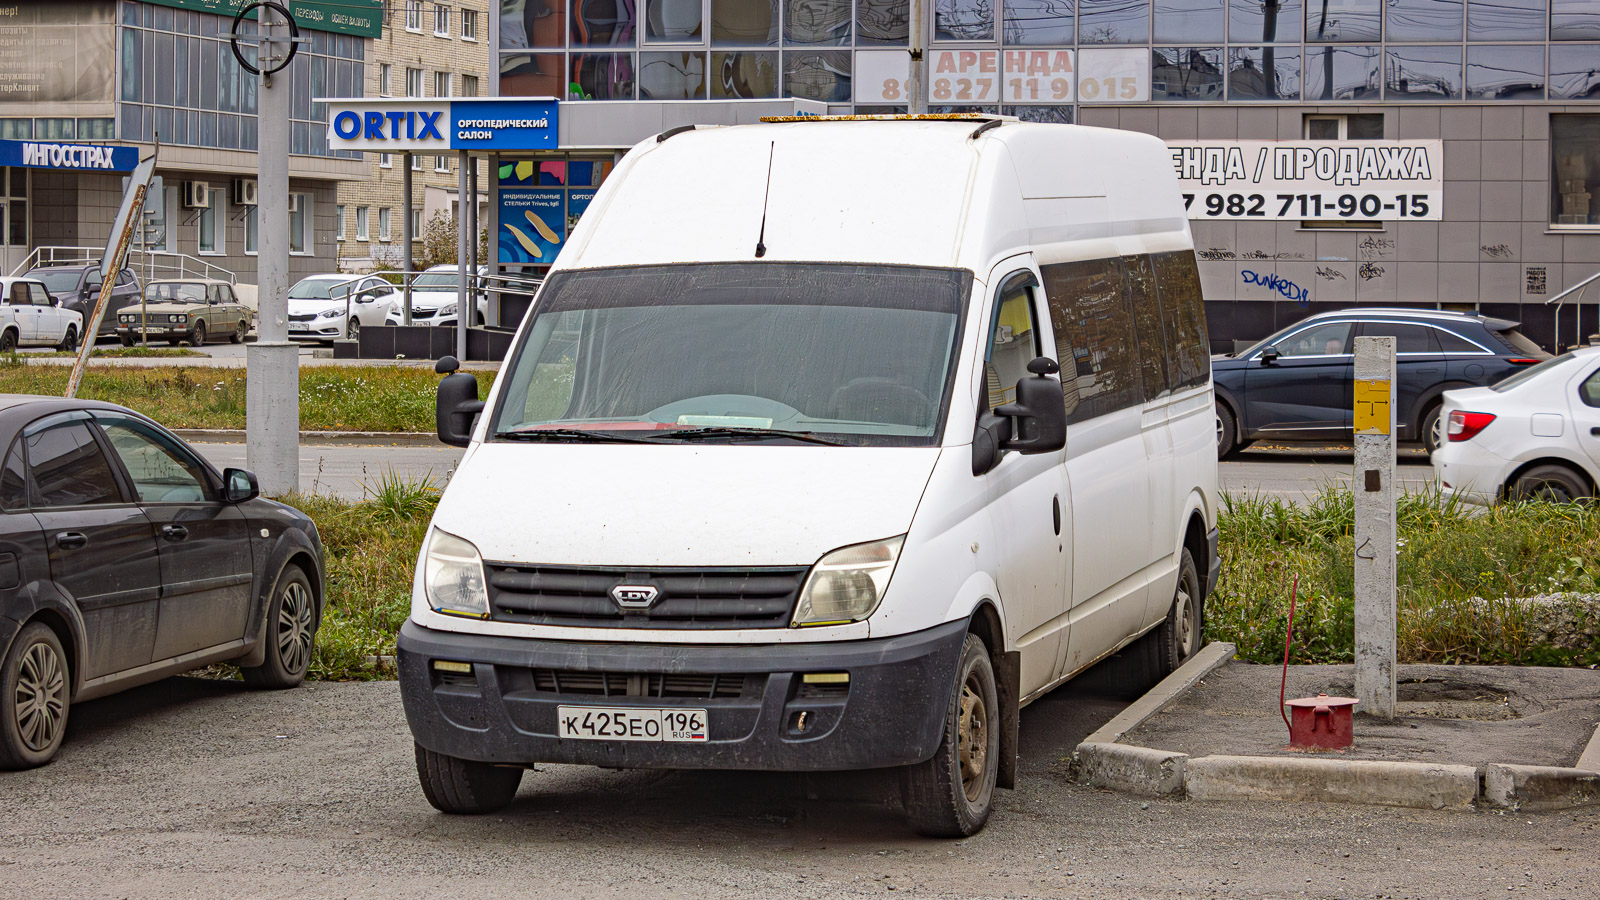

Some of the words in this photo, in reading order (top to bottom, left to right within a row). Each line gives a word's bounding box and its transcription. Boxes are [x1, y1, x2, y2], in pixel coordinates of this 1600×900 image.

[295, 8, 325, 22] ПЕРЕВОДЫ
[936, 51, 1073, 76] АРЕНДА
[882, 78, 909, 100] 8
[334, 111, 444, 140] ORTIX
[458, 118, 548, 129] ОРТОПЕДИЧЕСКИЙ
[458, 131, 492, 139] САЛОН
[22, 142, 114, 169] ИНГОССТРАХ
[1274, 147, 1431, 186] ПРОДАЖА
[1205, 193, 1266, 217] 982
[1276, 193, 1429, 217] 711-90-15
[664, 713, 701, 731] 196
